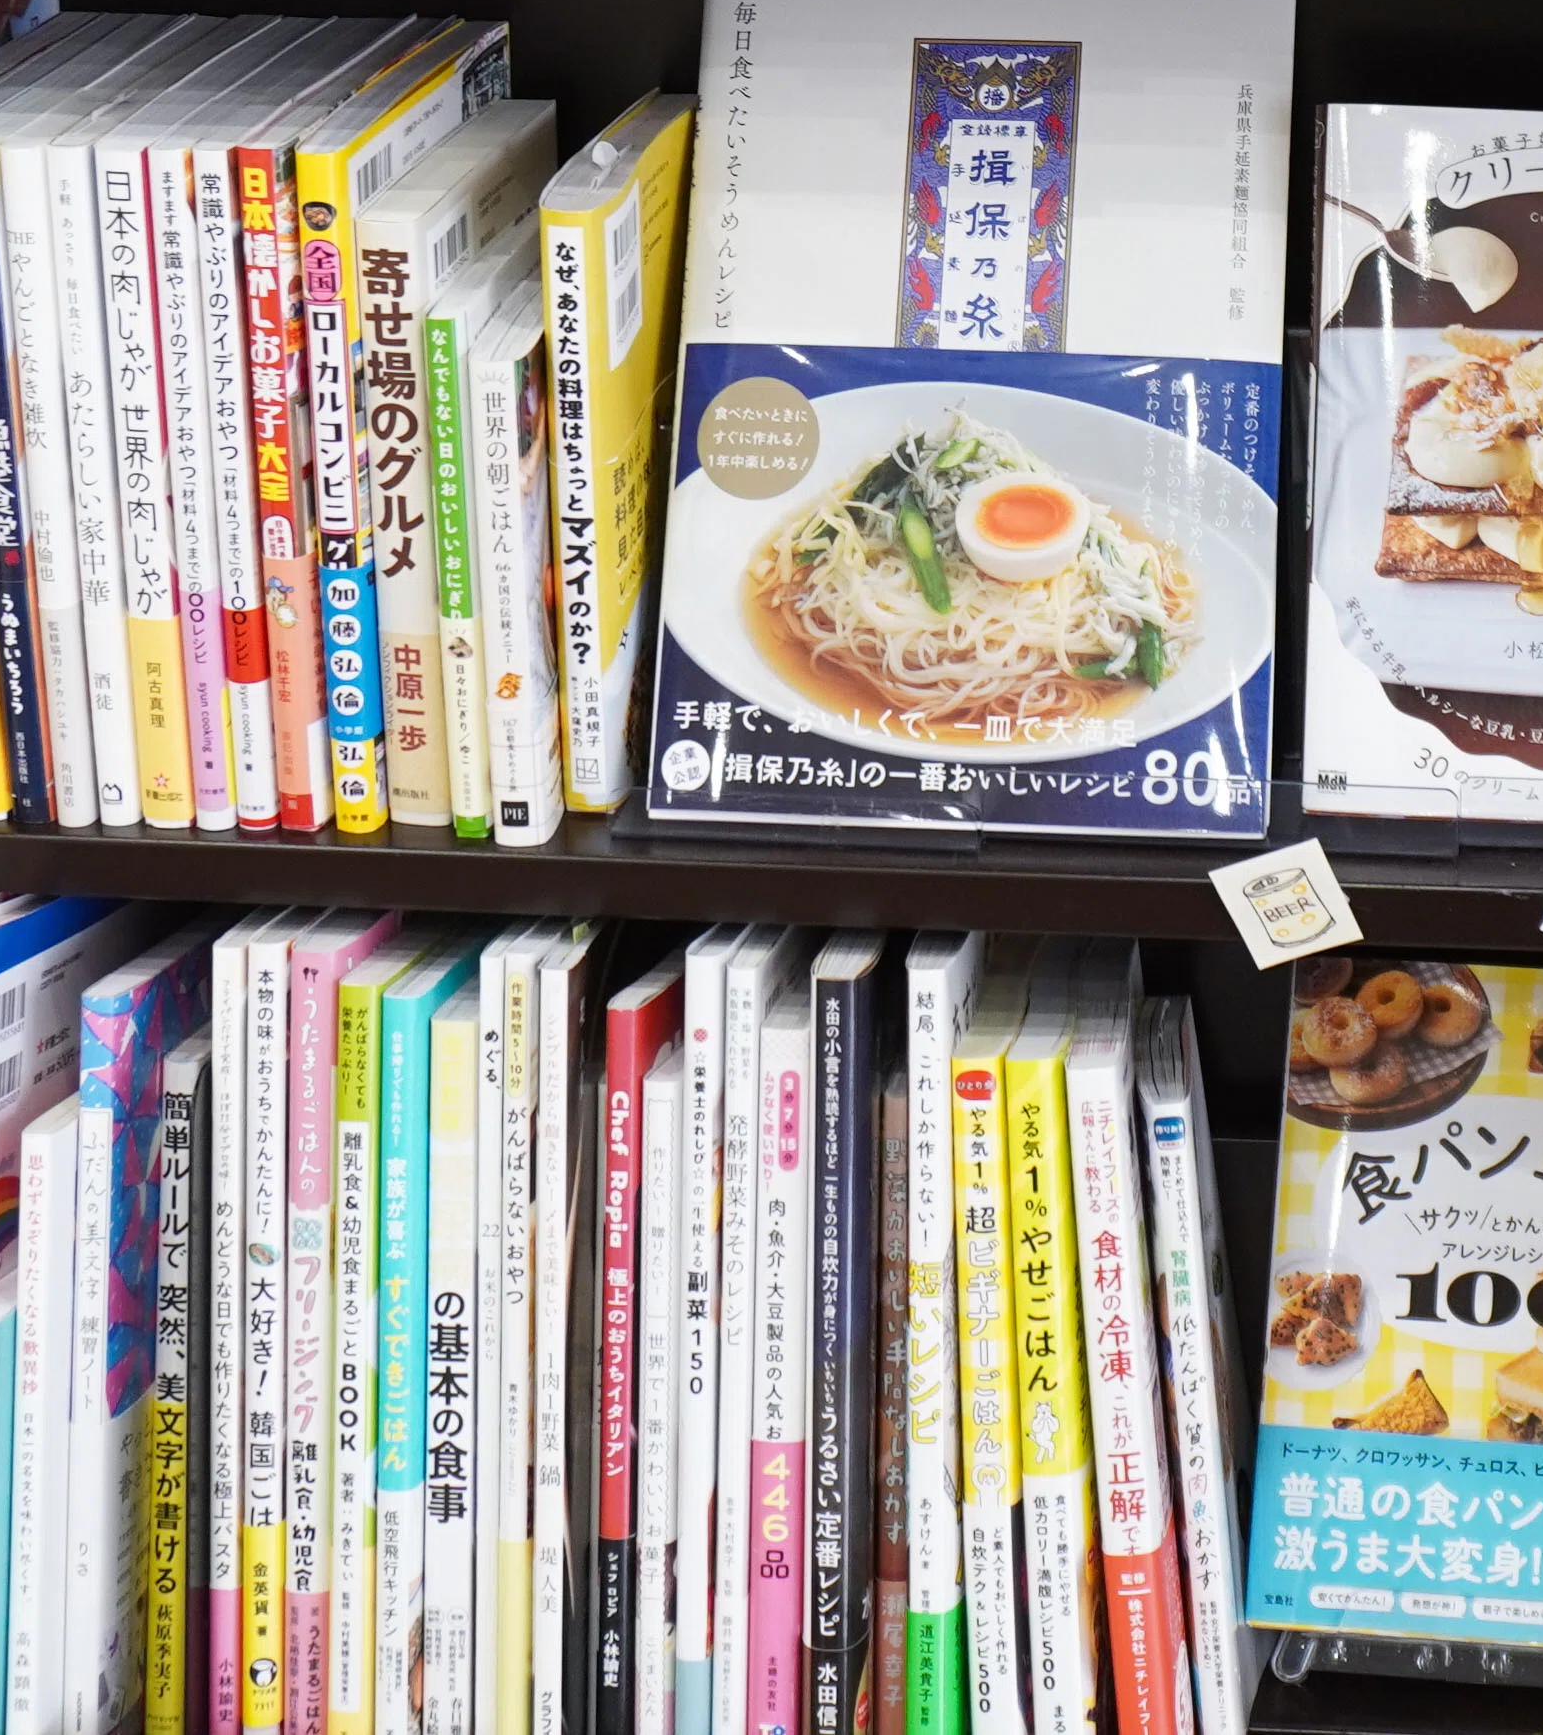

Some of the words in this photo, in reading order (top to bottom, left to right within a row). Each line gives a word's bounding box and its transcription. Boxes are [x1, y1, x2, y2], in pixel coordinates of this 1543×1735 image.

[713, 0, 758, 329] 毎日食べたいそうめんレシピ
[105, 171, 151, 393] 日本の肉じゃが
[241, 166, 290, 504] 日本懐かしお菓子大全
[67, 371, 110, 605] あたらしい家中華
[118, 405, 168, 617] 世界の肉じゃが
[360, 249, 427, 578] 寄せ場のグルメ
[482, 389, 514, 555] 世界の朝ごはん
[708, 453, 811, 472] 1年中楽しめる!
[713, 407, 810, 424] 食べたいときに
[713, 429, 805, 448] すぐに作れる!
[393, 643, 428, 751] 中原一歩
[1263, 895, 1317, 924] BEER
[159, 1092, 194, 1270] 簡単ルールで
[506, 1107, 528, 1306] がんばらないおやつ
[607, 1171, 626, 1249] Ropia
[609, 1090, 628, 1156] Chef
[153, 1281, 188, 1597] 突然、美文字が書ける
[604, 1267, 631, 1477] 極上のおうちイタリアン
[814, 1407, 841, 1638] うるさい定番レシピ
